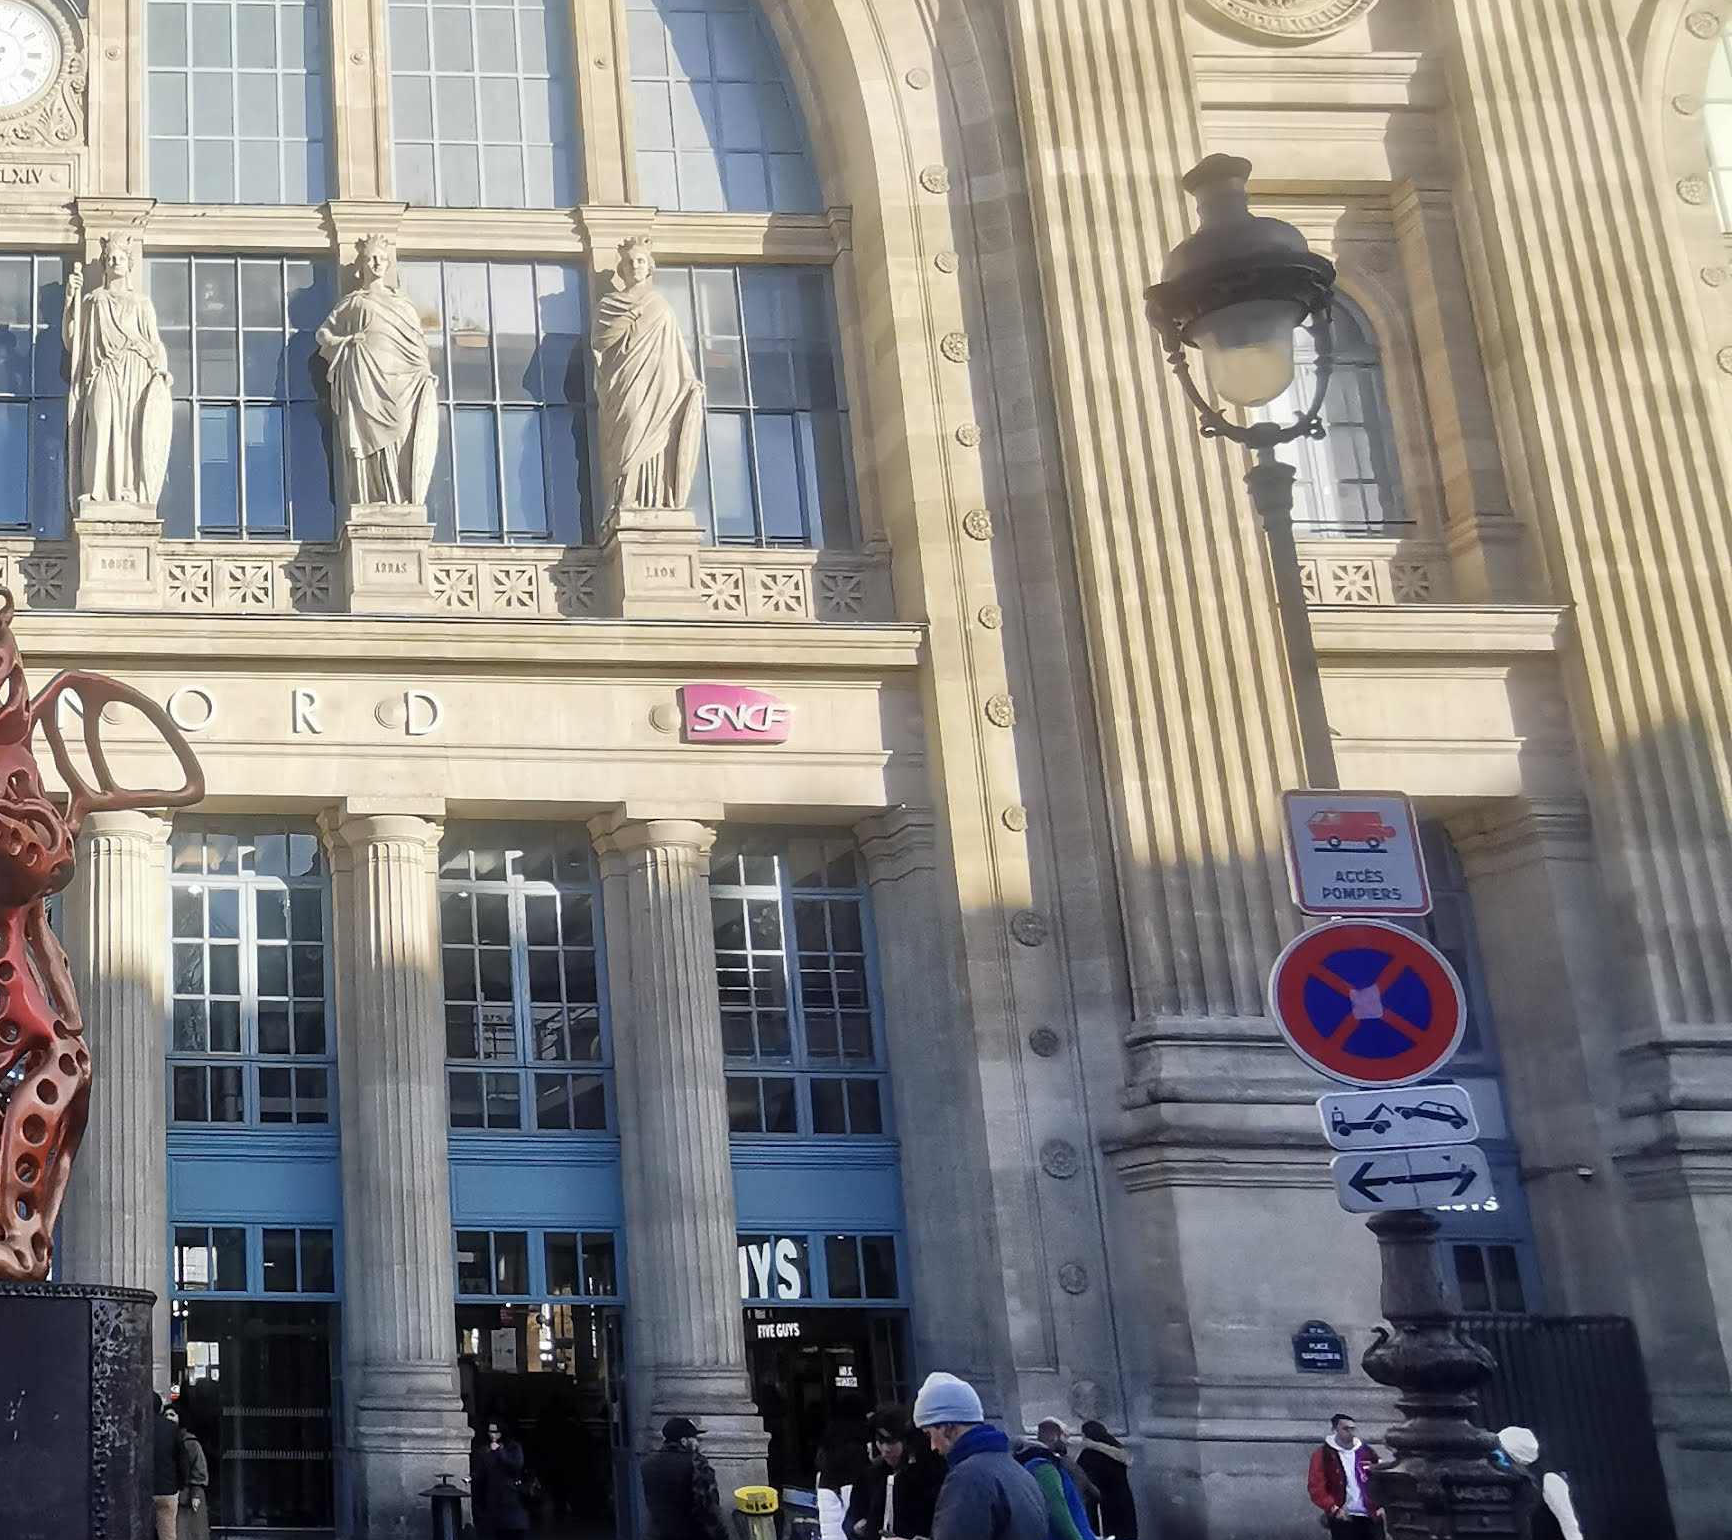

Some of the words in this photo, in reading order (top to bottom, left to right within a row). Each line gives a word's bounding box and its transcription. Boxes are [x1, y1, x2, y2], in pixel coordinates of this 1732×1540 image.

[374, 562, 408, 574] ARRAS
[645, 566, 676, 578] LAON
[690, 703, 796, 732] SNCF
[1322, 886, 1402, 900] POMPIERS
[757, 1323, 776, 1339] FIVE
[776, 1322, 801, 1338] GUYS
